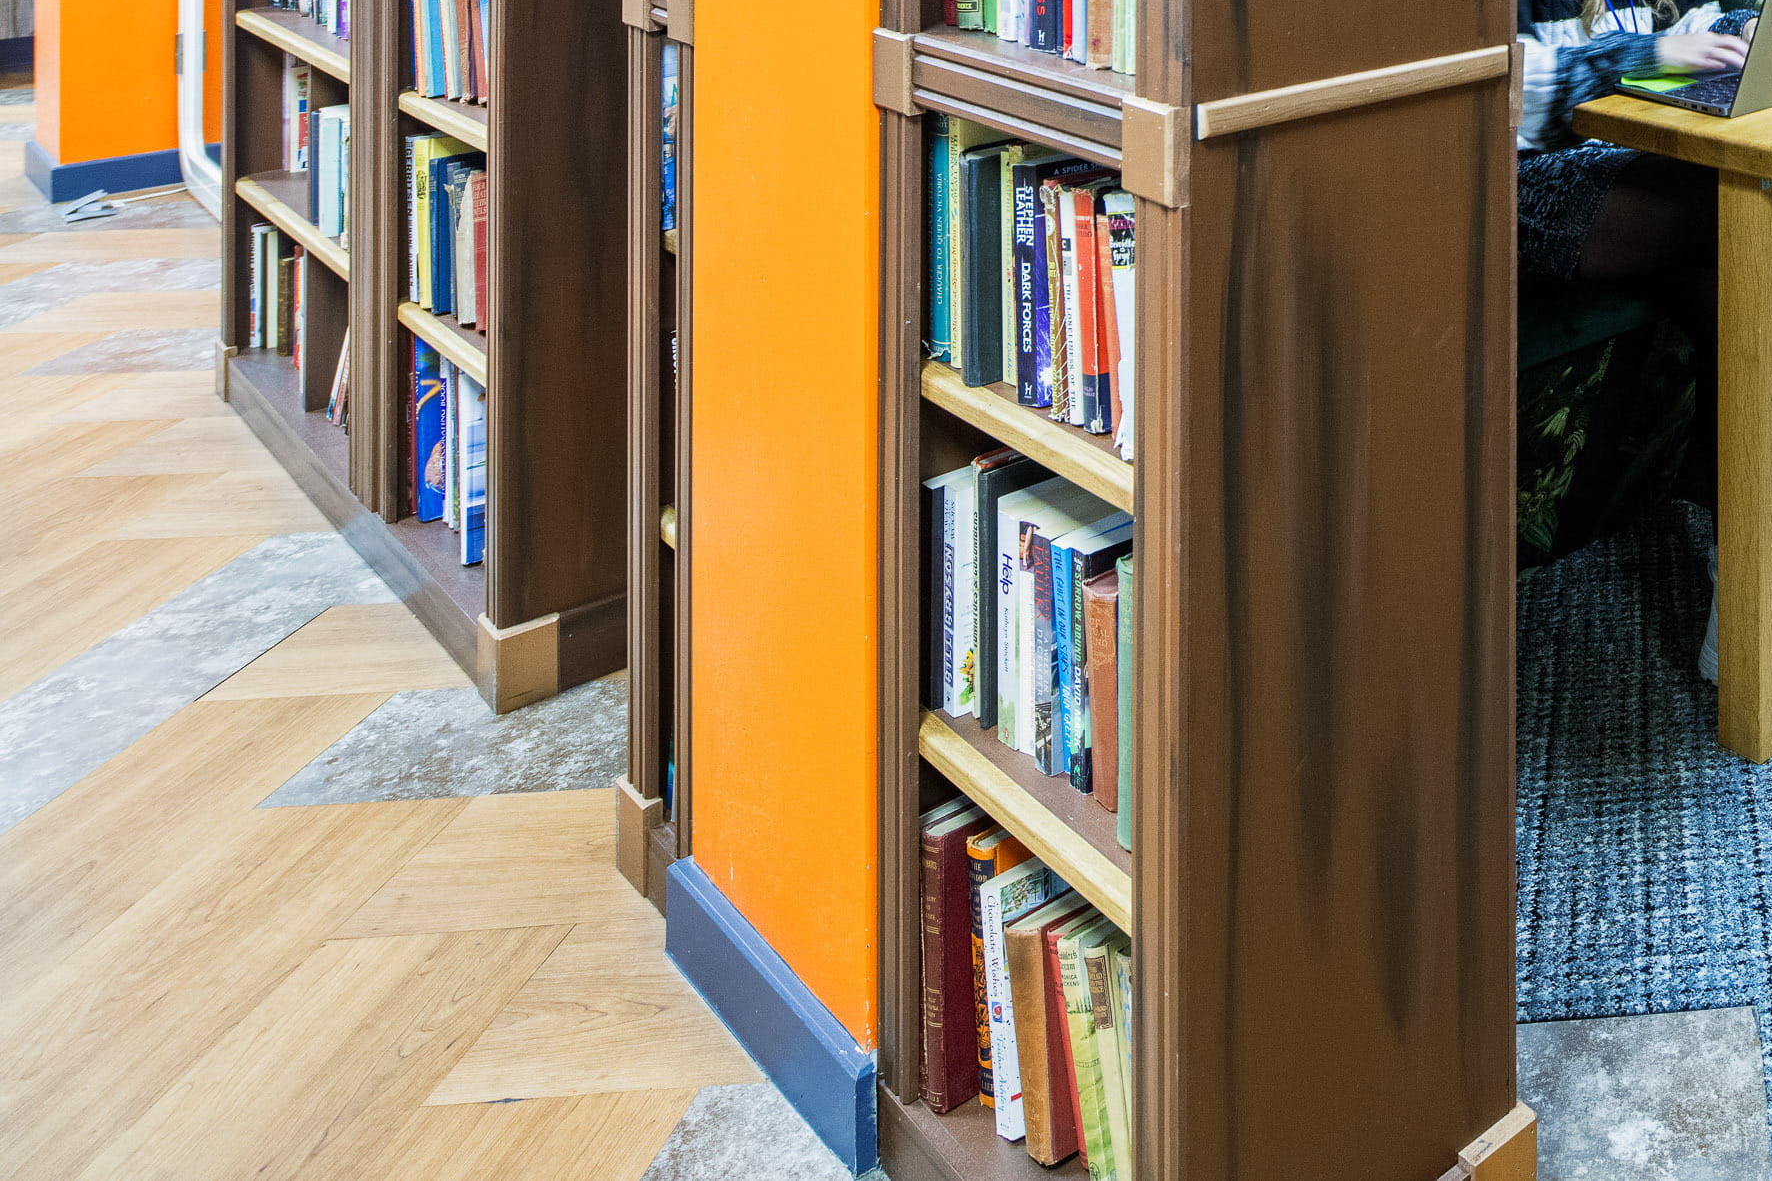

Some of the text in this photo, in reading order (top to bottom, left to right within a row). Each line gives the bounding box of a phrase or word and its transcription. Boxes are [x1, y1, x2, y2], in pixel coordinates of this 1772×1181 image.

[404, 148, 413, 217] GERRITSEN
[1062, 163, 1089, 175] SPIDER
[1015, 187, 1026, 244] LEATHER
[1024, 185, 1034, 247] STEPHEN
[936, 247, 943, 261] TO
[1021, 262, 1032, 354] DARK FORCES
[1066, 307, 1075, 371] LONELINESS
[439, 381, 447, 407] BOOK
[944, 545, 954, 632] BRYSON
[999, 553, 1014, 595] Help
[1034, 545, 1045, 619] FAULKS
[1043, 550, 1051, 622] SEBASTIAN
[1054, 551, 1063, 572] THE
[1056, 577, 1065, 604] FAULT
[1002, 607, 1010, 639] Kathryn
[1059, 621, 1067, 639] OUR
[944, 634, 954, 687] BILL
[1036, 628, 1044, 698] DECEMBER
[1060, 644, 1070, 674] STARS
[1073, 572, 1083, 748] SORROW BOUND DAVID MARK
[1061, 683, 1072, 750] JOHN GREEN
[987, 895, 1001, 998] Chocolate Wishes
